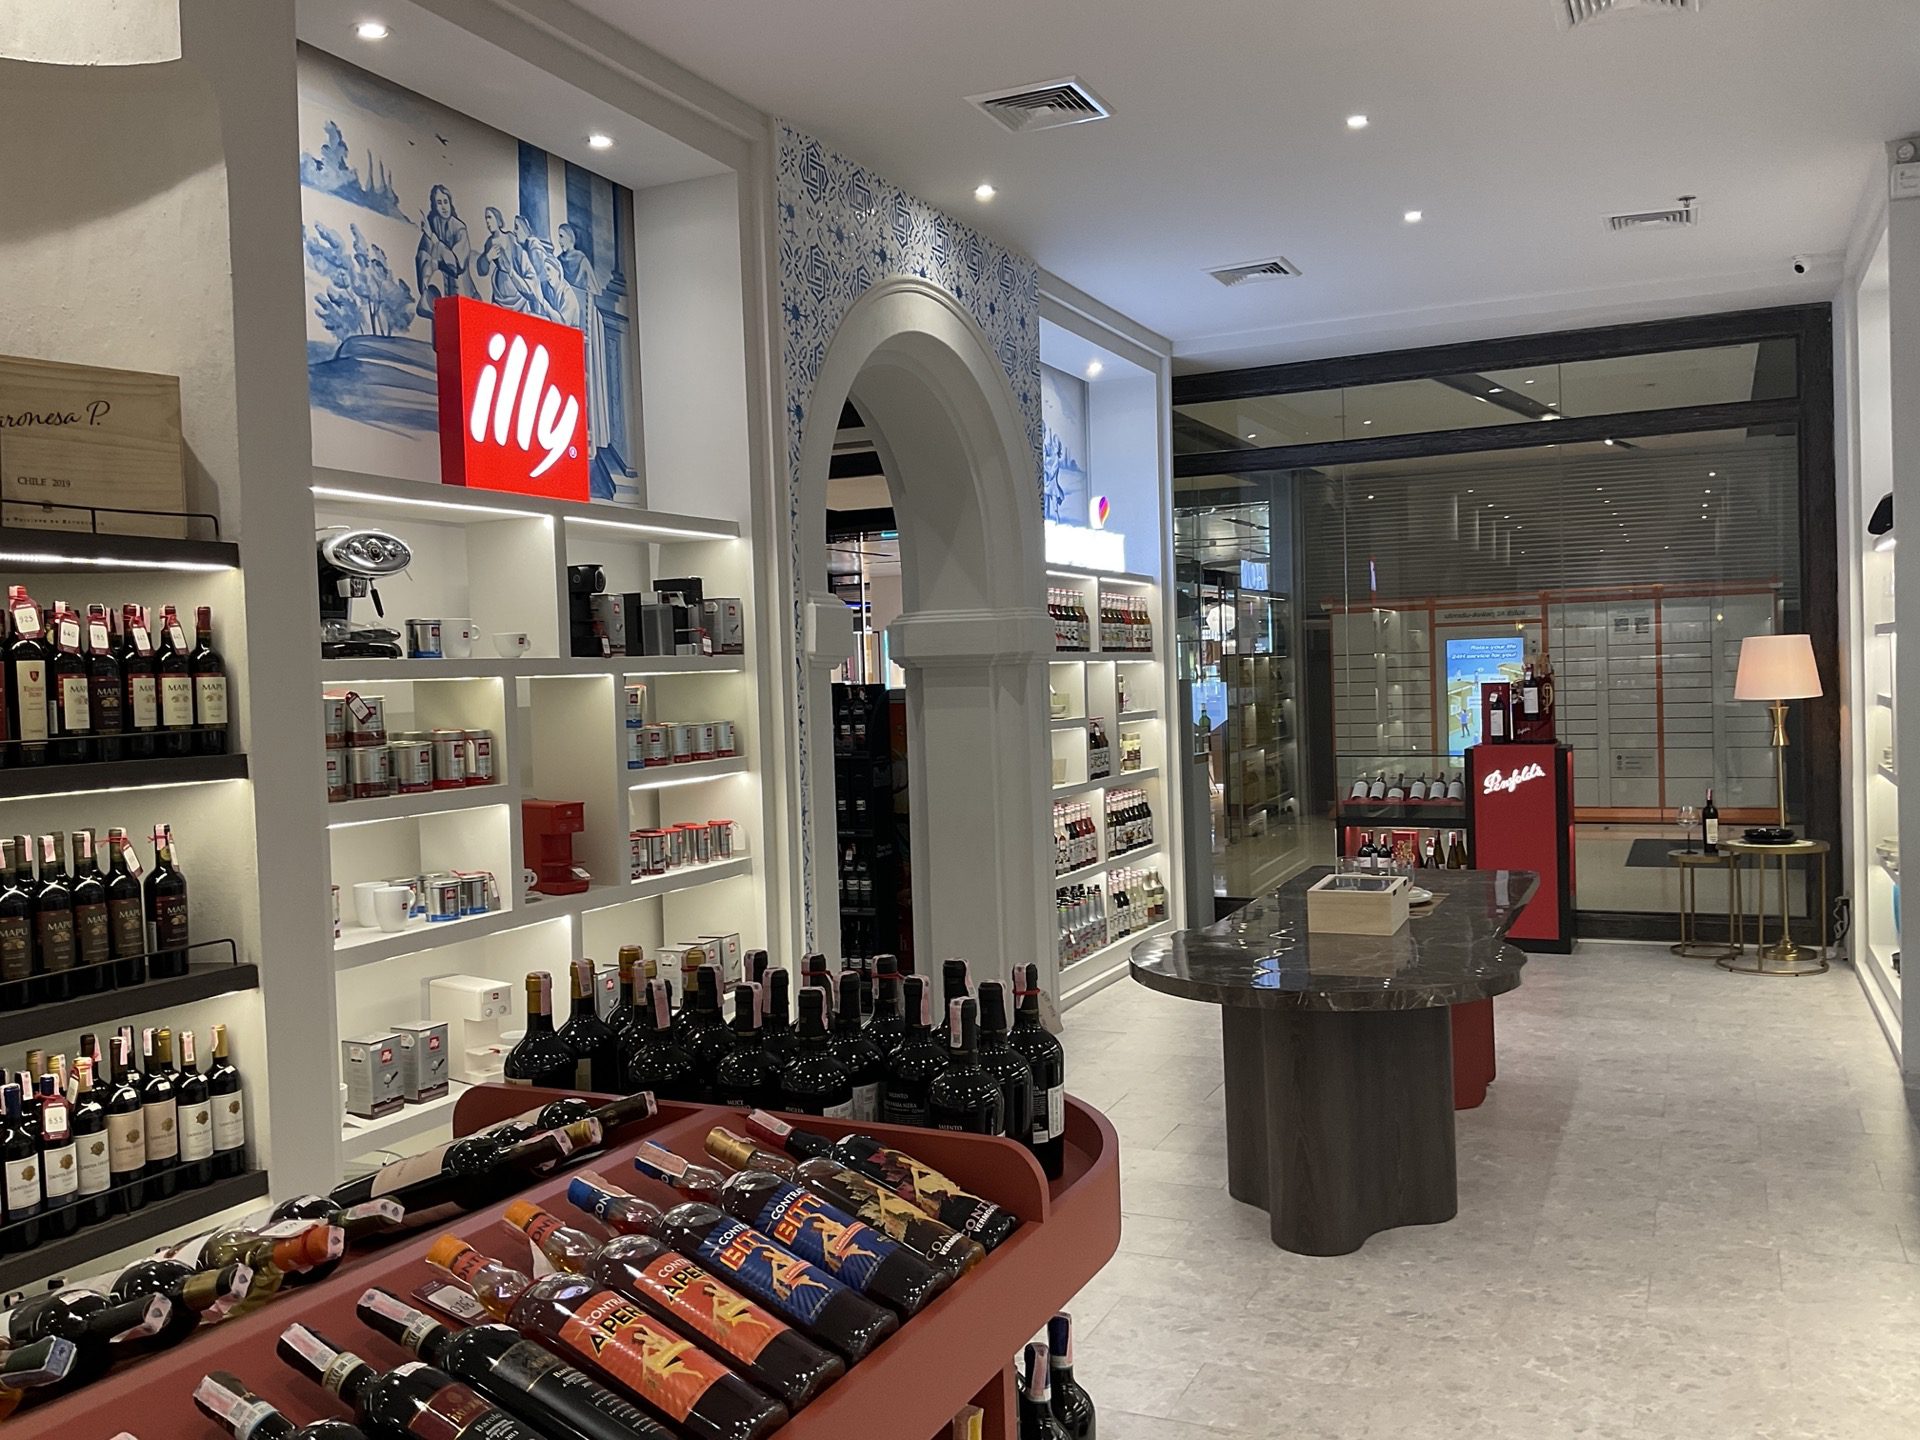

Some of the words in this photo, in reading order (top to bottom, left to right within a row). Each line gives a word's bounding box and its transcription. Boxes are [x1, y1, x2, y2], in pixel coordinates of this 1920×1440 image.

[86, 400, 111, 427] P.
[470, 333, 579, 478] illy
[17, 477, 47, 487] CHILE
[52, 478, 72, 489] 2019
[474, 1412, 503, 1433] Barolo
